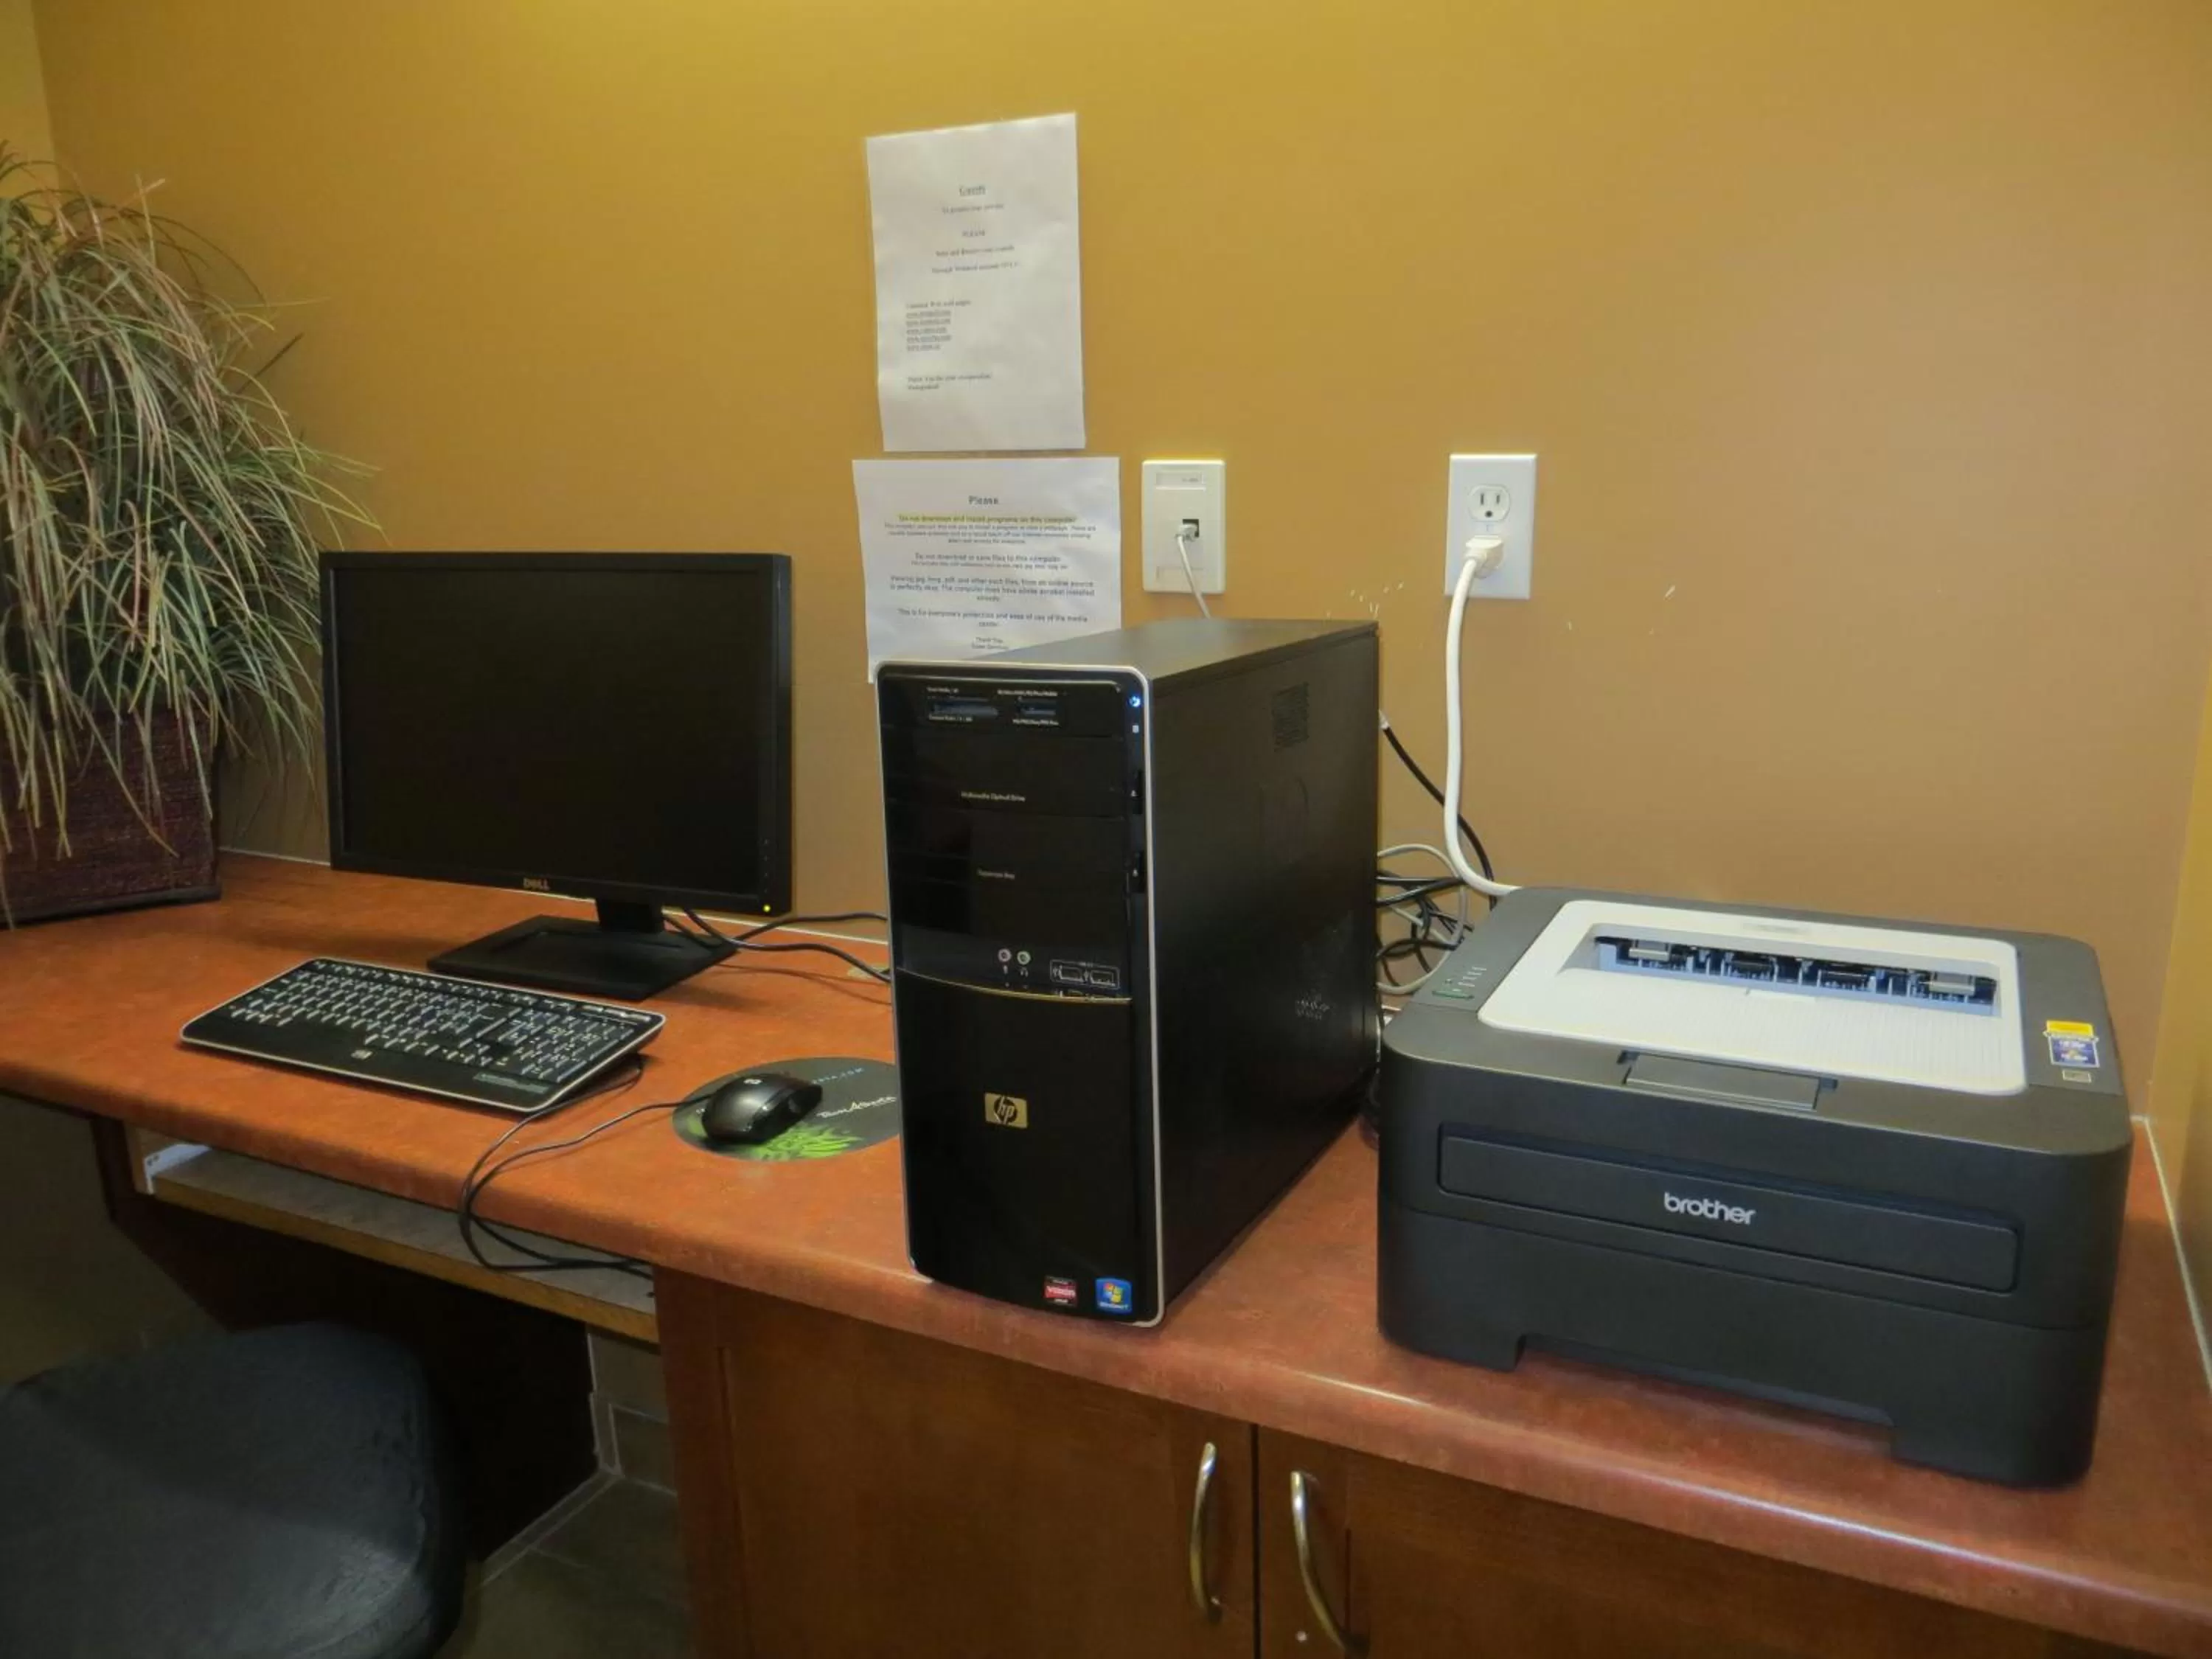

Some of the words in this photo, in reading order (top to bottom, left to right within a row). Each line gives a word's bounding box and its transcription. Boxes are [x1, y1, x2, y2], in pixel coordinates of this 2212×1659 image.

[523, 877, 552, 891] DELL
[995, 1096, 1016, 1125] hp
[1663, 1192, 1757, 1225] brother
